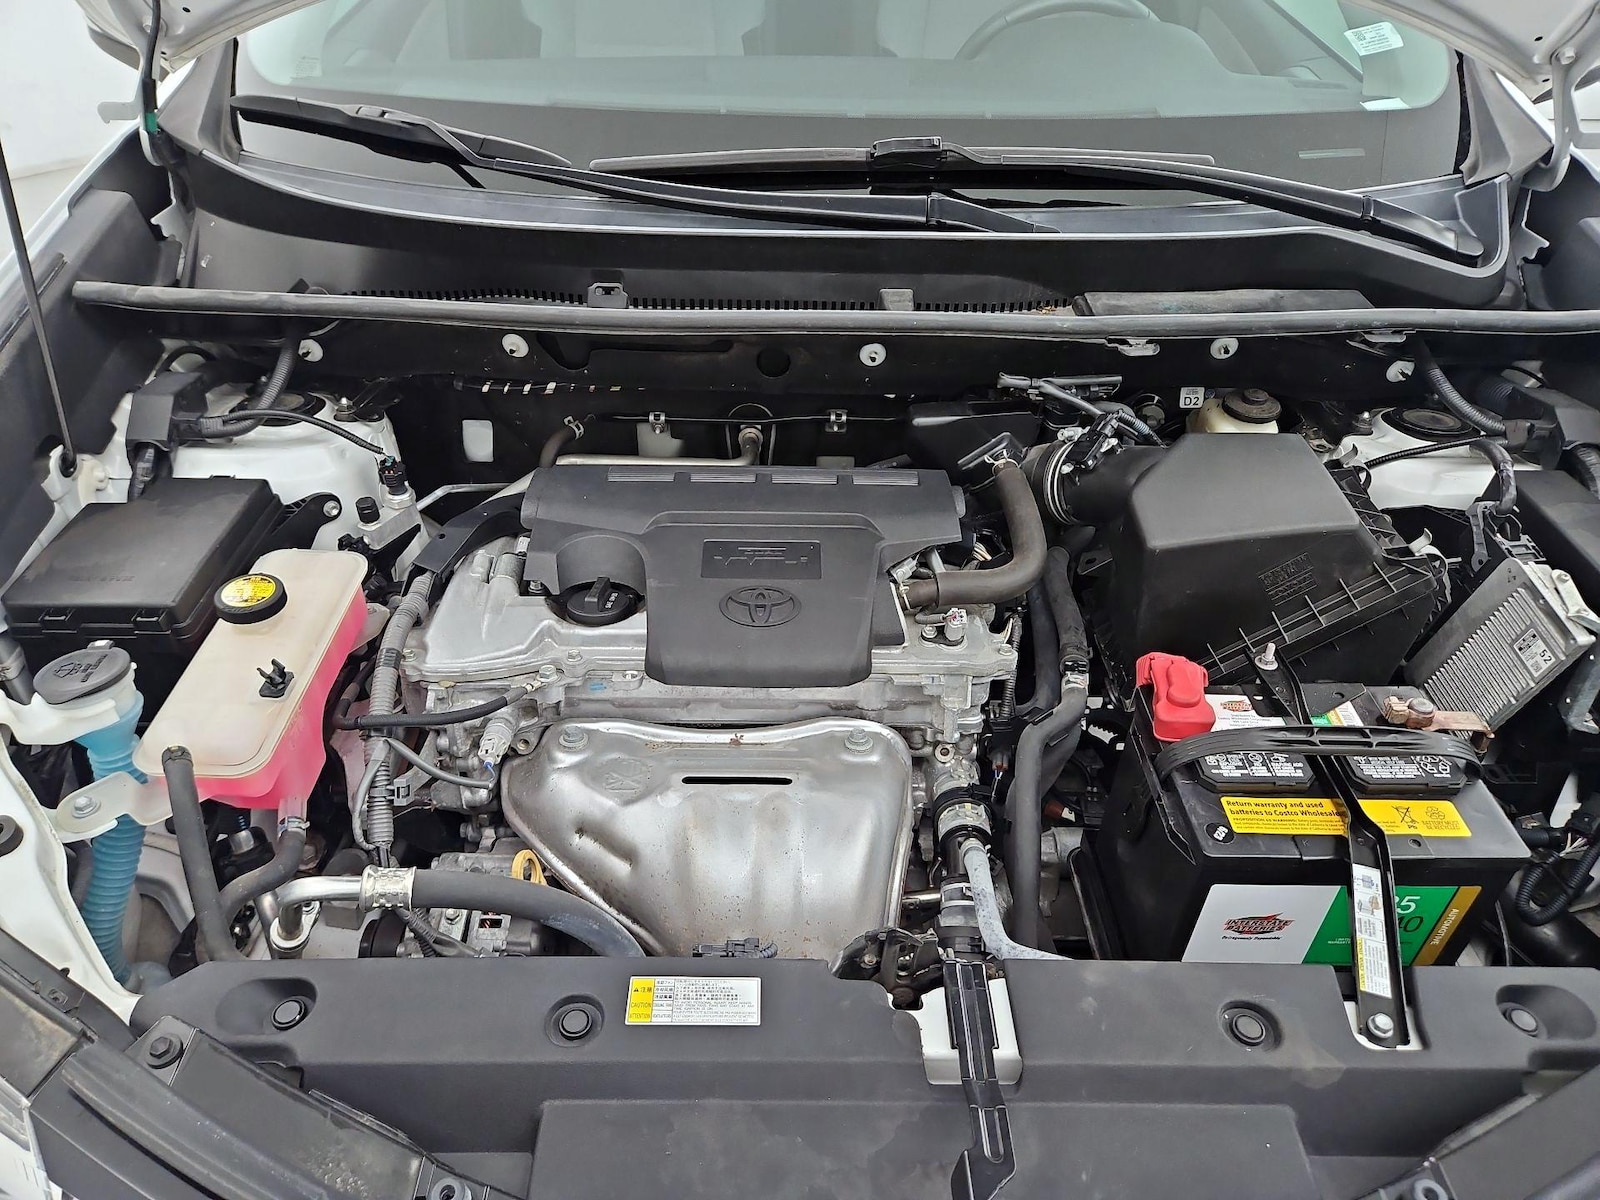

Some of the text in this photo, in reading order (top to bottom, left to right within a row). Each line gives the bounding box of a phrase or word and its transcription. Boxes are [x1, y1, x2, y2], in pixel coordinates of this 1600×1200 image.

[1184, 397, 1200, 406] D2
[1539, 649, 1553, 664] 52
[1254, 801, 1288, 809] warranty
[1305, 801, 1324, 809] used
[1273, 809, 1299, 817] Costco
[1224, 918, 1295, 926] INTERSTATE
[1430, 908, 1460, 946] AUTOMOTIVE
[630, 1001, 652, 1009] CAUTION
[629, 1012, 651, 1020] ATTENTION
